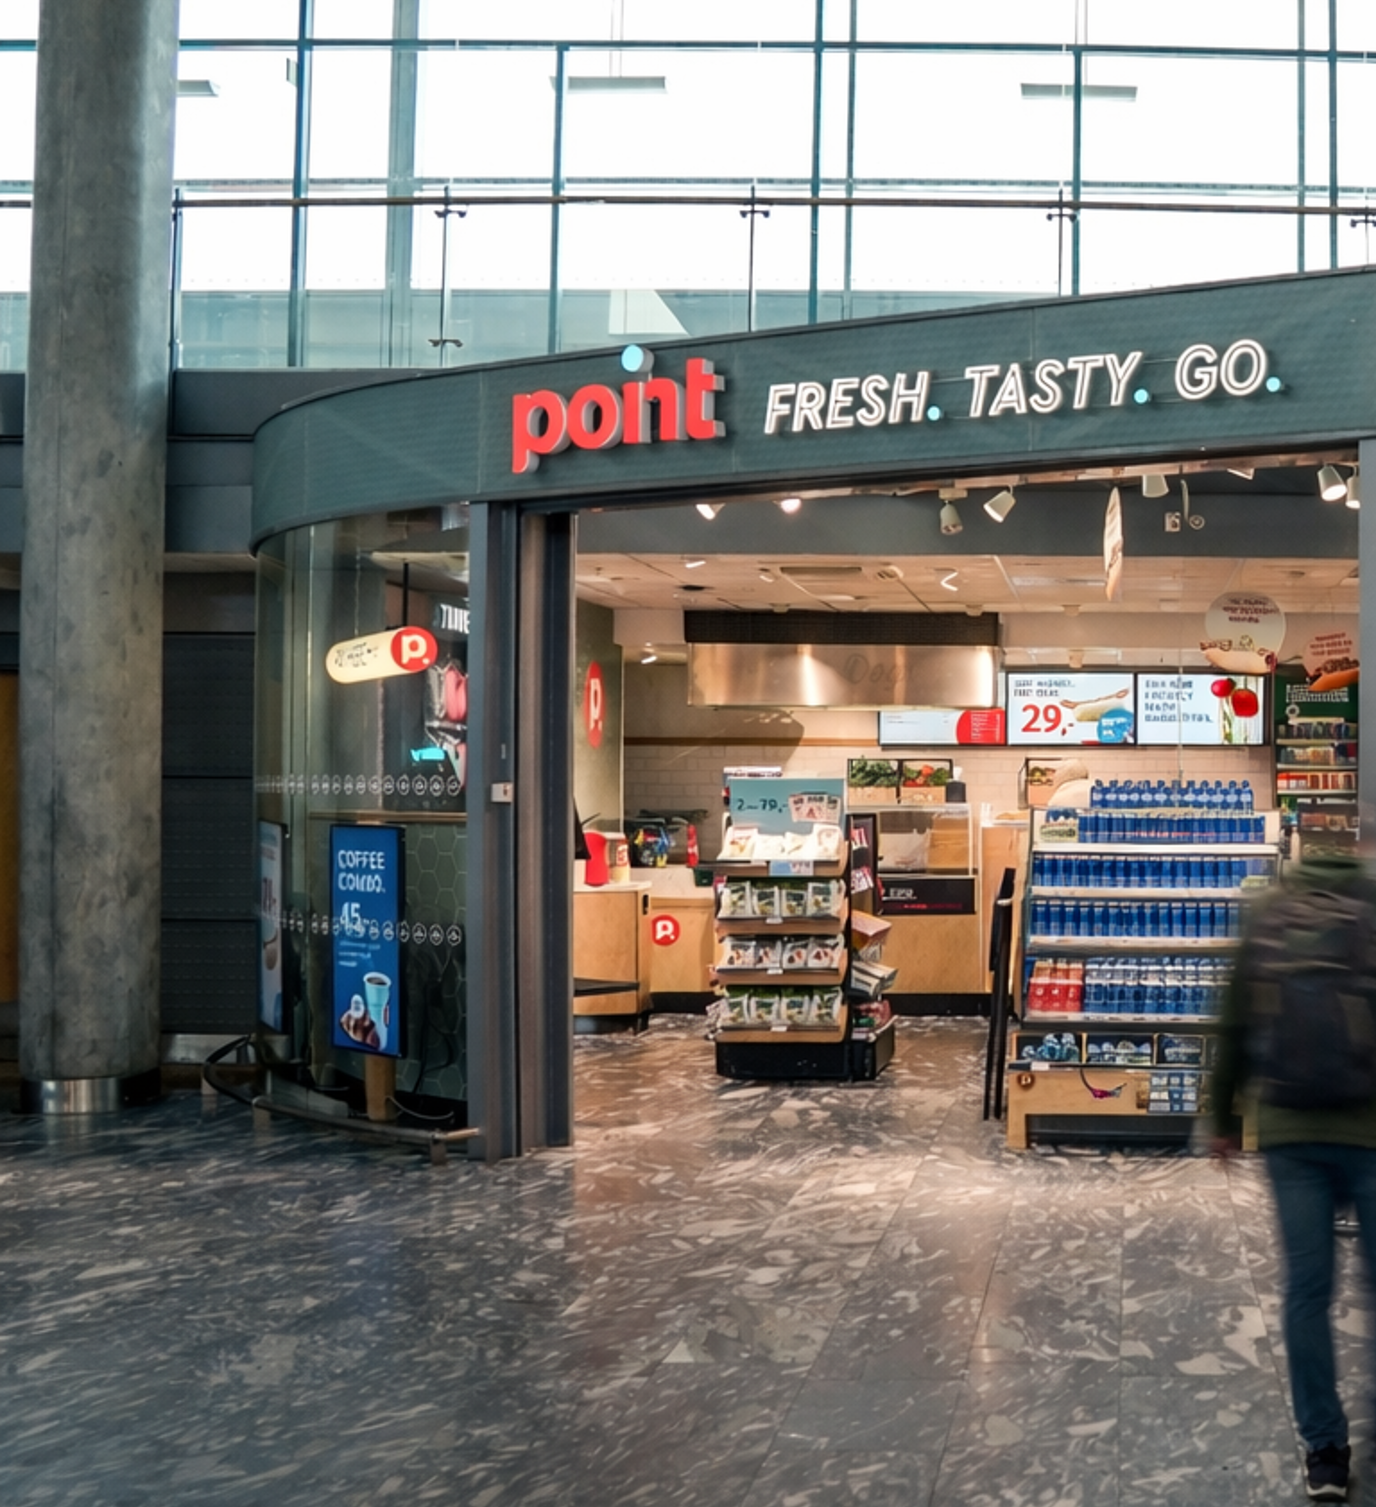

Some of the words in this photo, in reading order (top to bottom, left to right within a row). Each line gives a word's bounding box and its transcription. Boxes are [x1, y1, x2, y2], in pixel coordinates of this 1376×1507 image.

[511, 344, 726, 475] point
[764, 370, 942, 434] FRESH.
[964, 350, 1150, 418] TASTY.
[1174, 338, 1281, 400] GO.
[338, 849, 386, 870] COFFEE
